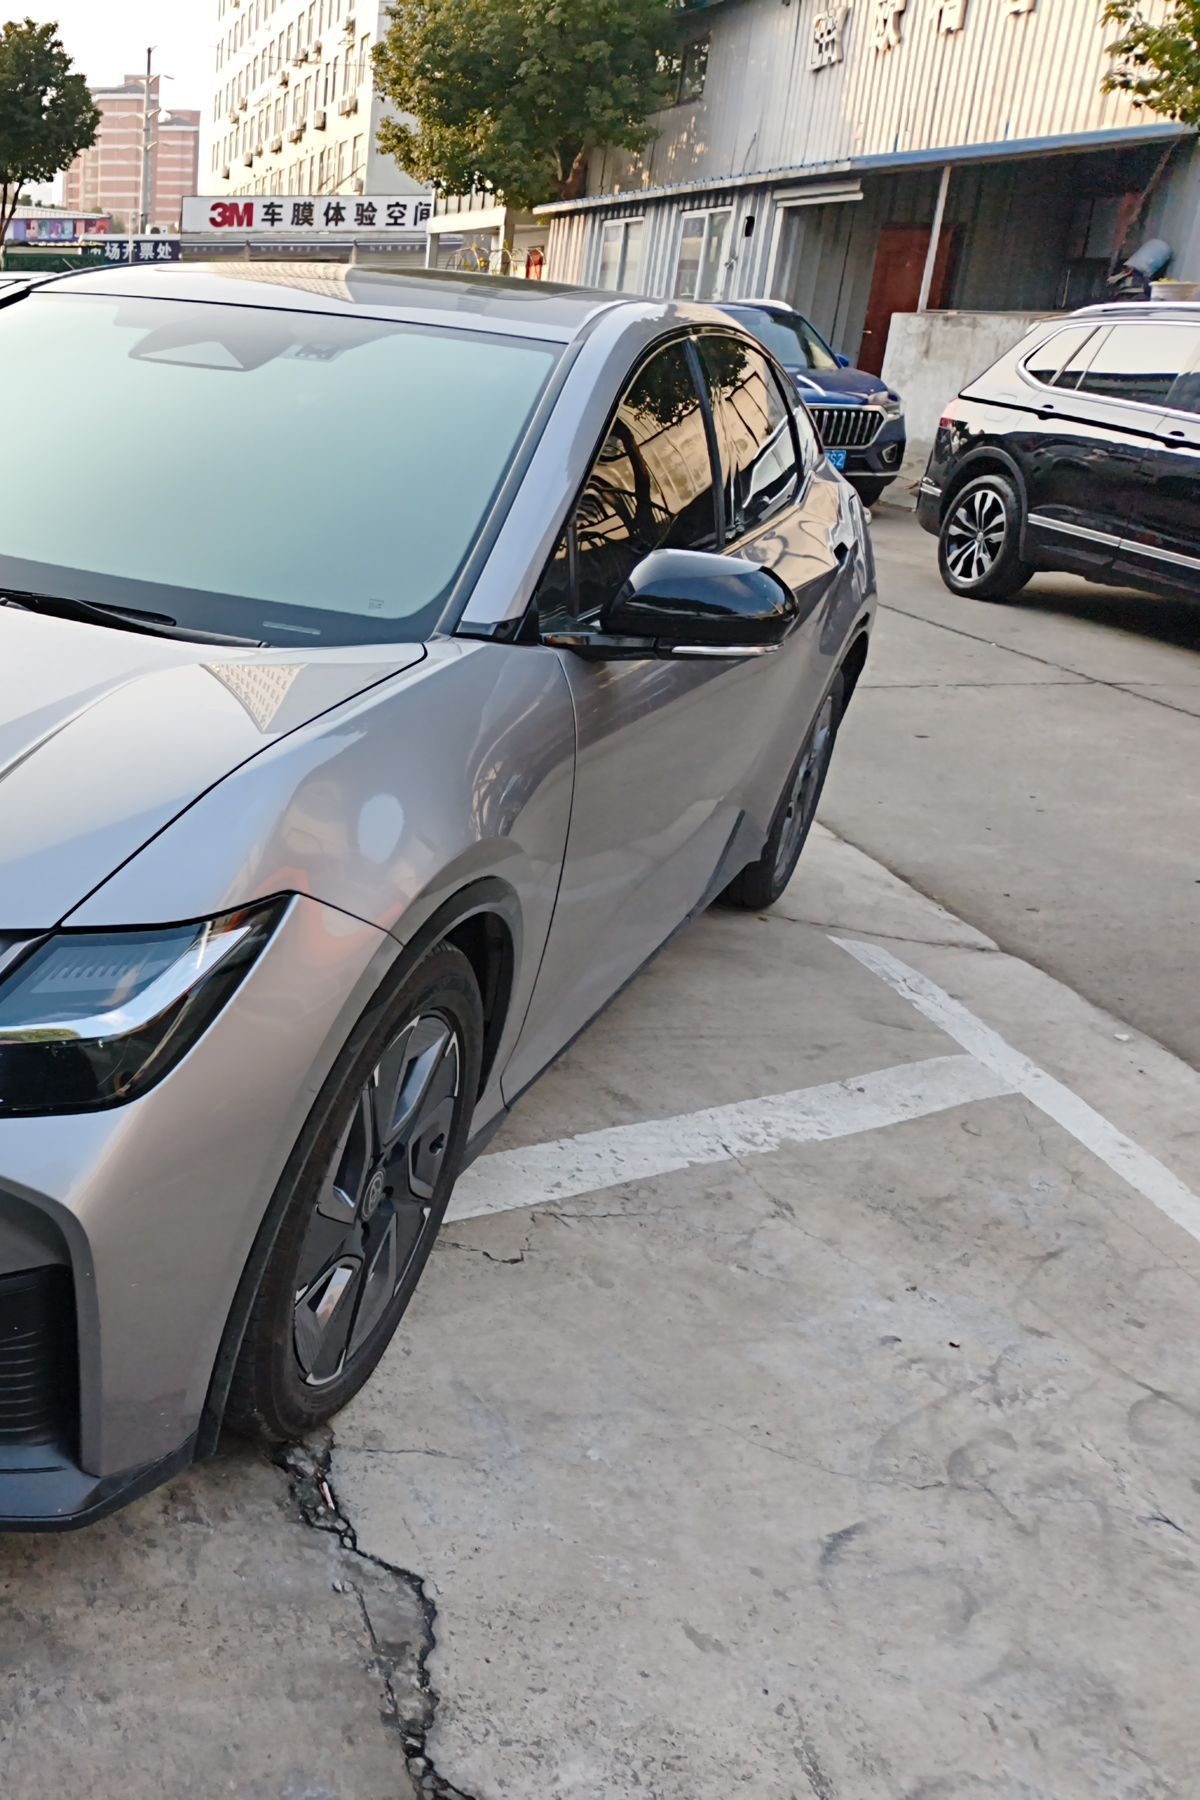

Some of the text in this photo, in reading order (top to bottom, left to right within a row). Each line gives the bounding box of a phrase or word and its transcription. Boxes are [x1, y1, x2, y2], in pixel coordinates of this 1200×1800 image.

[209, 202, 432, 228] 3M 车膜体验空间
